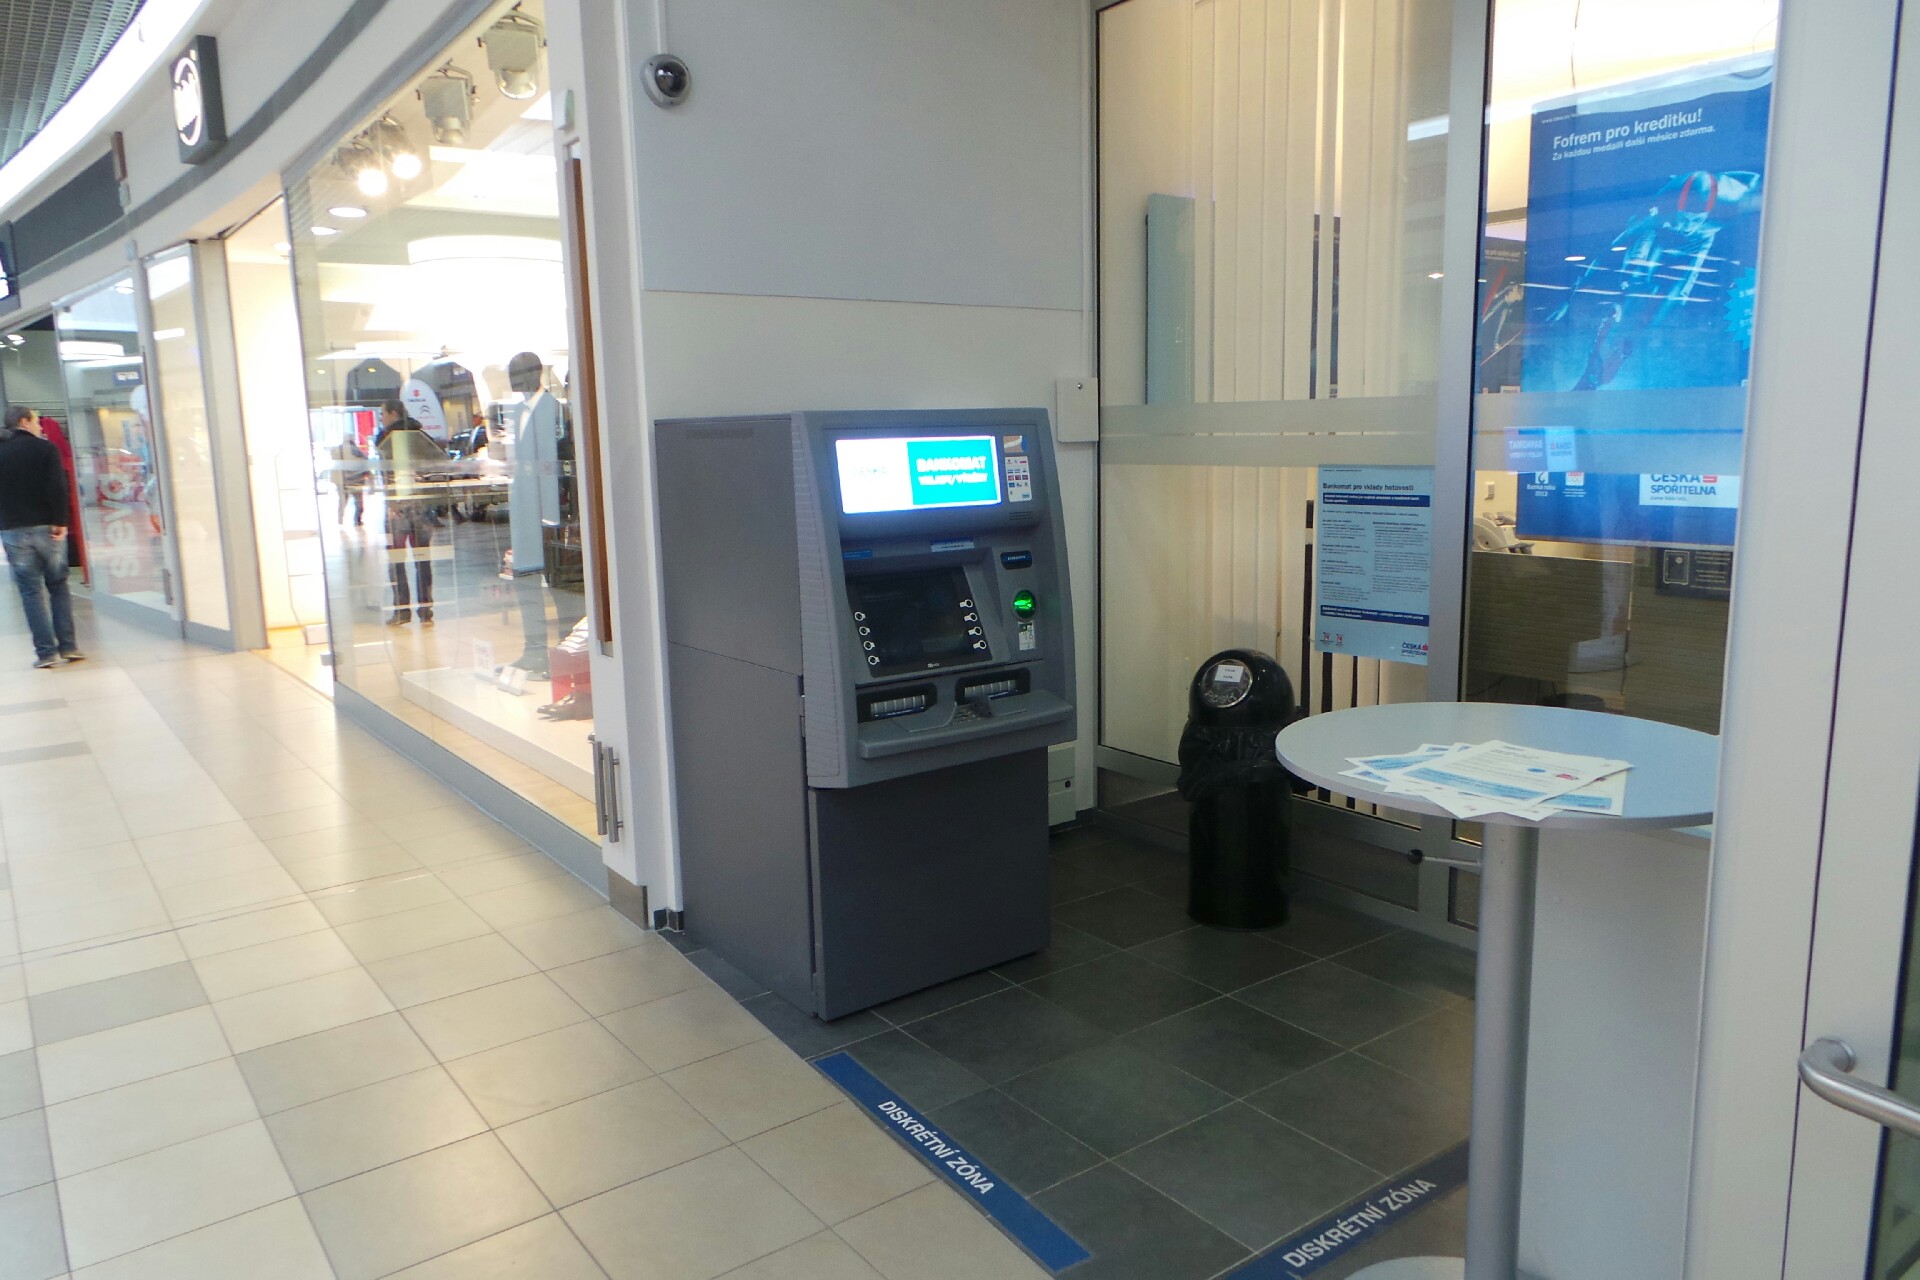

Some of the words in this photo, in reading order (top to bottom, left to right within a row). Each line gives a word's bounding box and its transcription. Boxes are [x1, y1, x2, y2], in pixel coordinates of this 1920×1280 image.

[1552, 151, 1563, 161] Za
[1564, 147, 1592, 159] každou
[1593, 141, 1624, 153] medaili
[1679, 125, 1716, 138] zdarma.
[1553, 130, 1601, 149] Fofrem
[1605, 124, 1631, 142] pro
[1633, 108, 1704, 134] kreditku!
[916, 456, 987, 472] BANKOMAT
[1650, 482, 1717, 496] SPOŘITELNA
[878, 1101, 961, 1159] DISKRÉTNÍ
[945, 1156, 995, 1195] ZÓNA
[1282, 1201, 1388, 1268] DISKRÉTNÍ
[1378, 1179, 1437, 1211] ZÓNA
